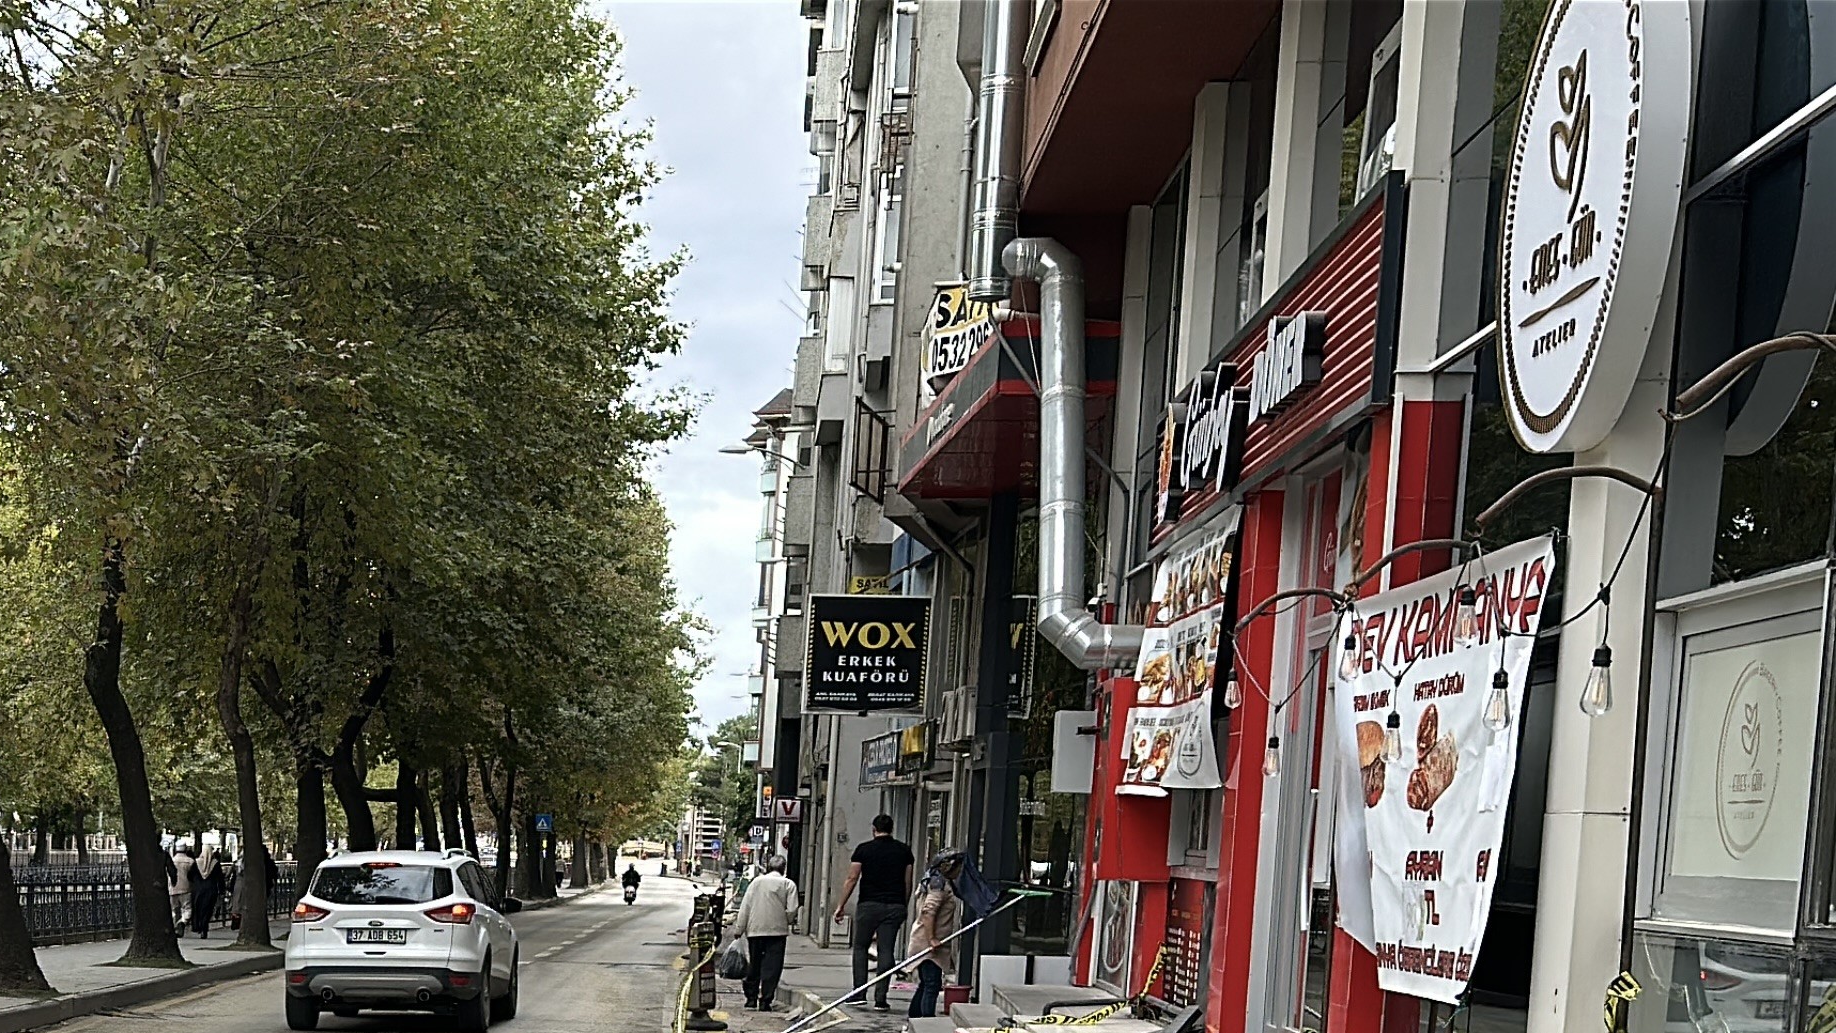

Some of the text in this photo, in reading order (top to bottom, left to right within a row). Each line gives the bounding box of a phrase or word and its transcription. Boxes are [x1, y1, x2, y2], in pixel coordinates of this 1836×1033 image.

[1532, 317, 1576, 358] ATELIER
[931, 332, 967, 374] 0532
[1248, 310, 1307, 427] DÖNER
[820, 620, 917, 649] WOX
[822, 668, 910, 683] KUAFÖRÜ
[837, 655, 897, 667] ERKEK
[352, 930, 364, 941] 37
